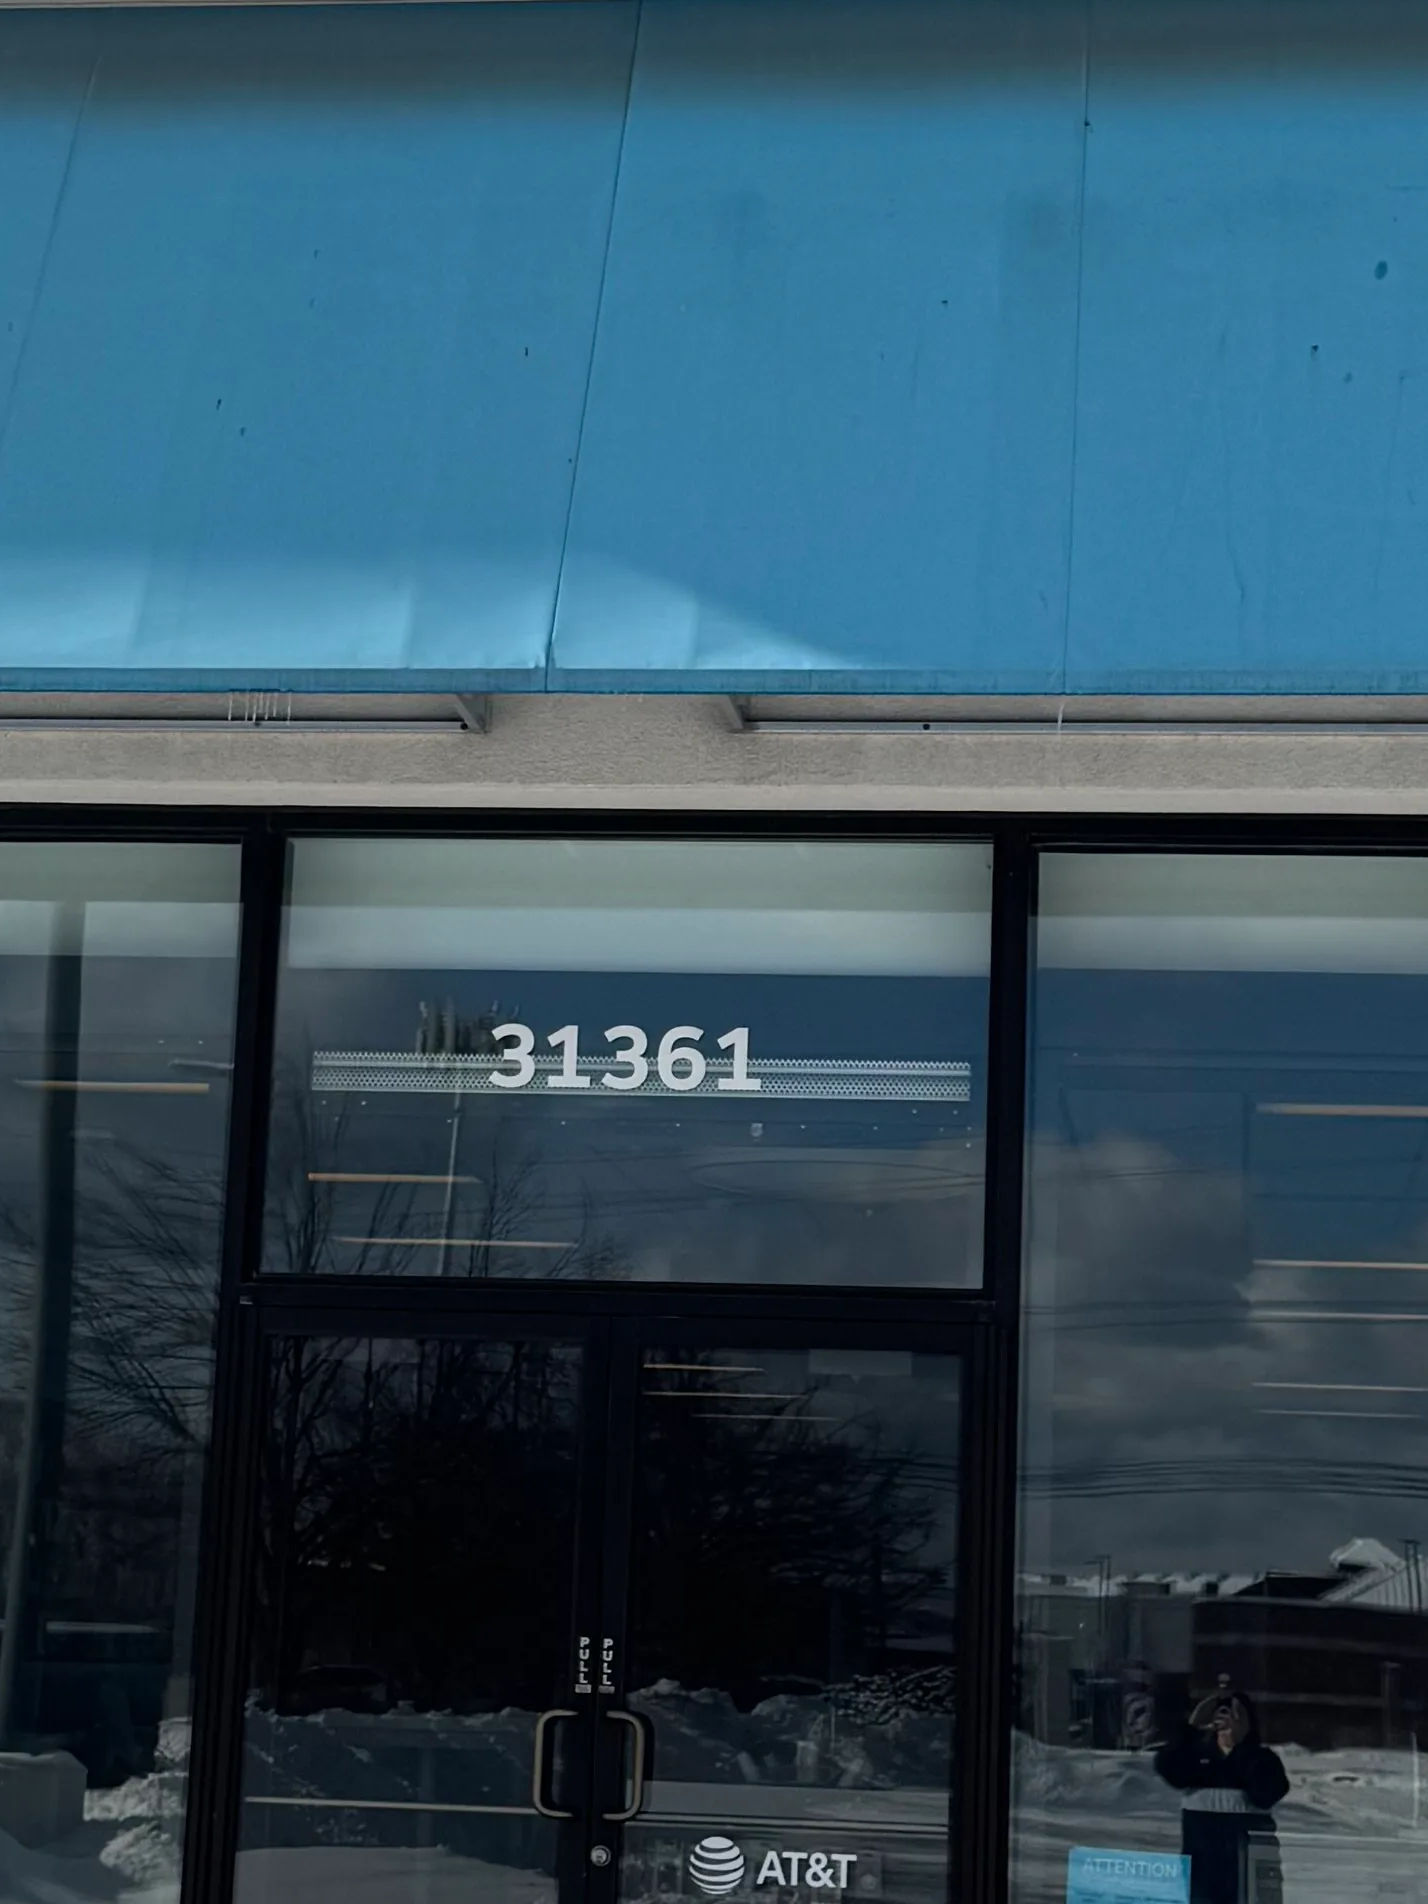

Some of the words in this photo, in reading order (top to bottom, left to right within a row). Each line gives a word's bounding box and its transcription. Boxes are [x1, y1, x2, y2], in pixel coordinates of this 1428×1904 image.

[488, 1022, 763, 1091] 31361
[579, 1636, 591, 1684] PULL
[602, 1637, 614, 1685] PULL
[755, 1850, 858, 1889] AT&T
[1083, 1856, 1178, 1878] ATTENTION
